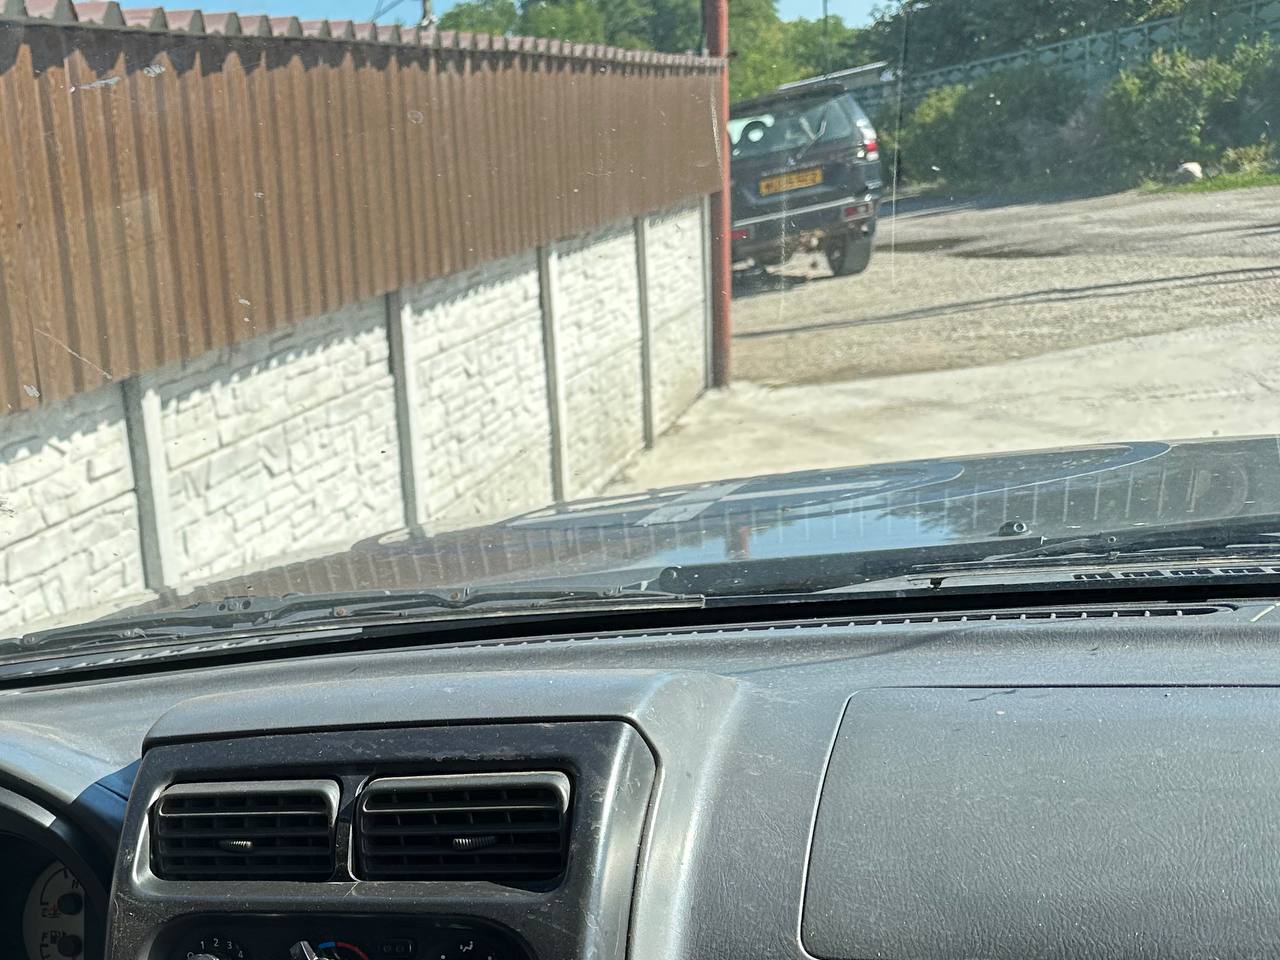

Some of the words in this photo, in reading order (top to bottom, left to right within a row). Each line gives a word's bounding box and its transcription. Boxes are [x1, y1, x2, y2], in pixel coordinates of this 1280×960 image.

[212, 937, 220, 947] 2
[226, 940, 233, 950] 3
[237, 950, 245, 959] 4
